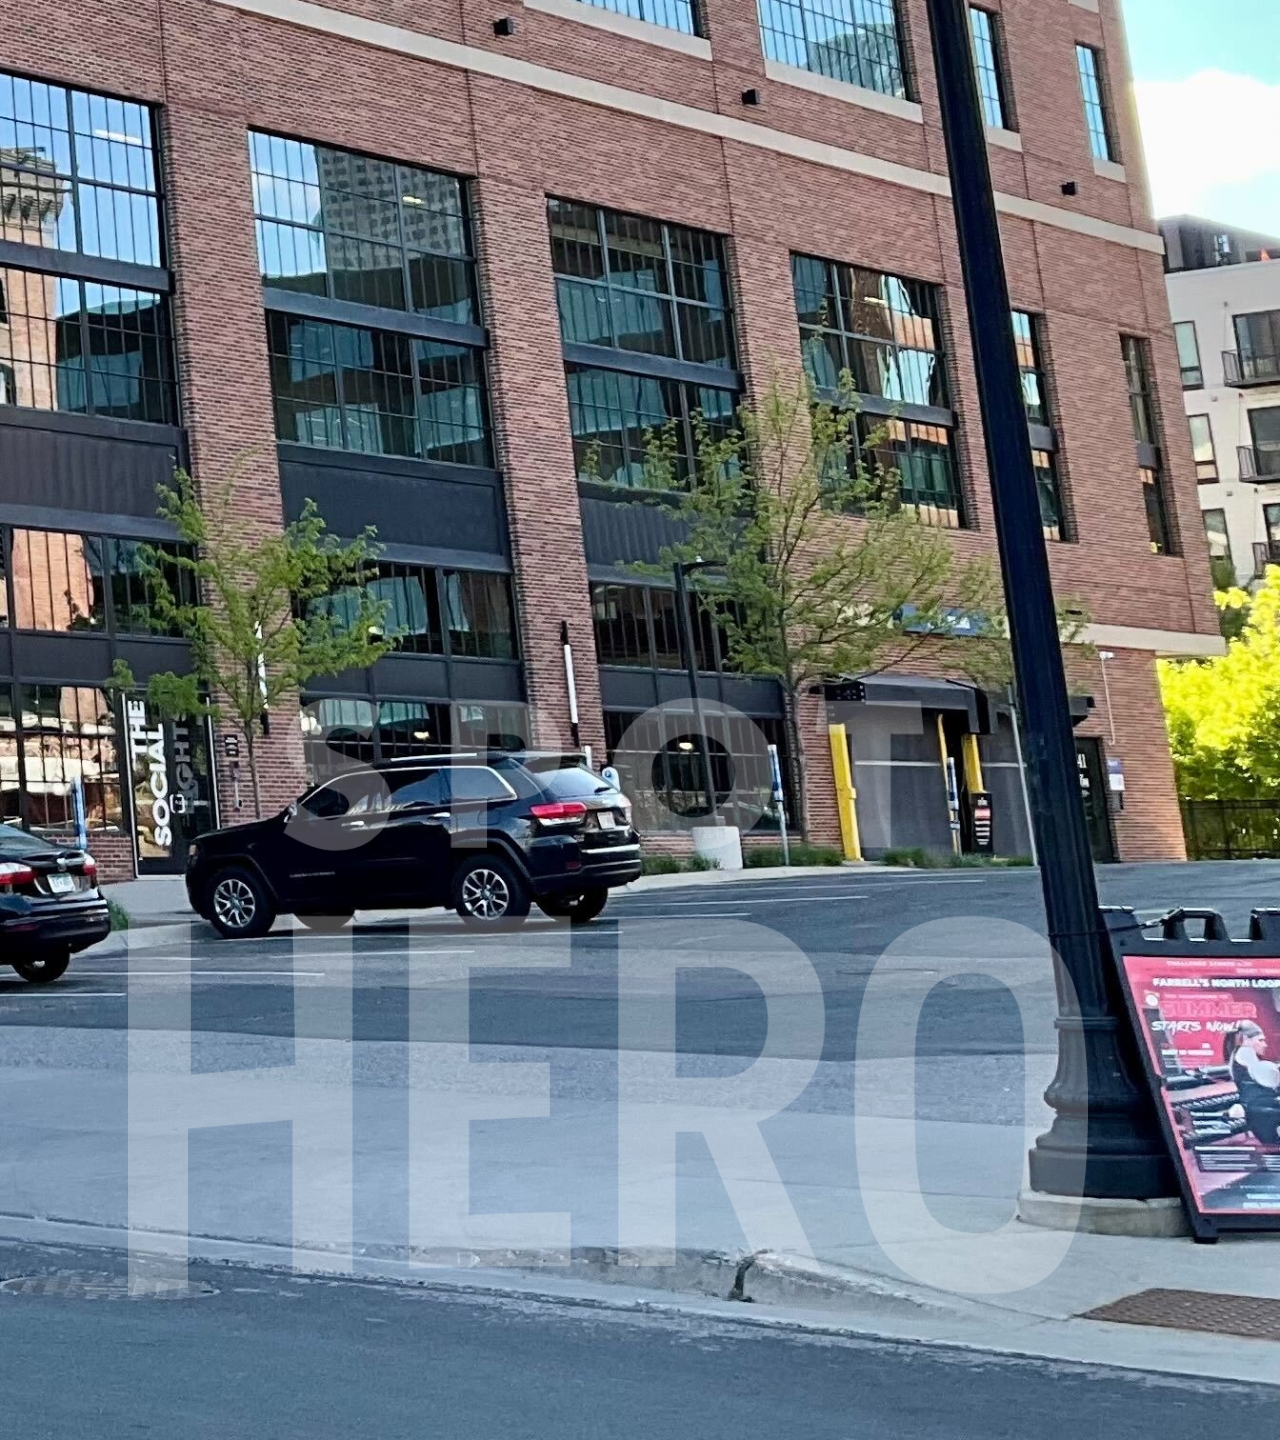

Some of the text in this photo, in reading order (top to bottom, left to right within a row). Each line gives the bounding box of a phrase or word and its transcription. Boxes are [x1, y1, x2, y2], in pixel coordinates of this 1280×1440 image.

[127, 700, 148, 770] THE
[146, 723, 172, 846] SOCIAL
[1152, 977, 1209, 988] FARRELL'S
[1211, 978, 1250, 988] NORTH
[1162, 1002, 1257, 1018] SUMMER
[1151, 1020, 1240, 1034] STARTS NOW!
